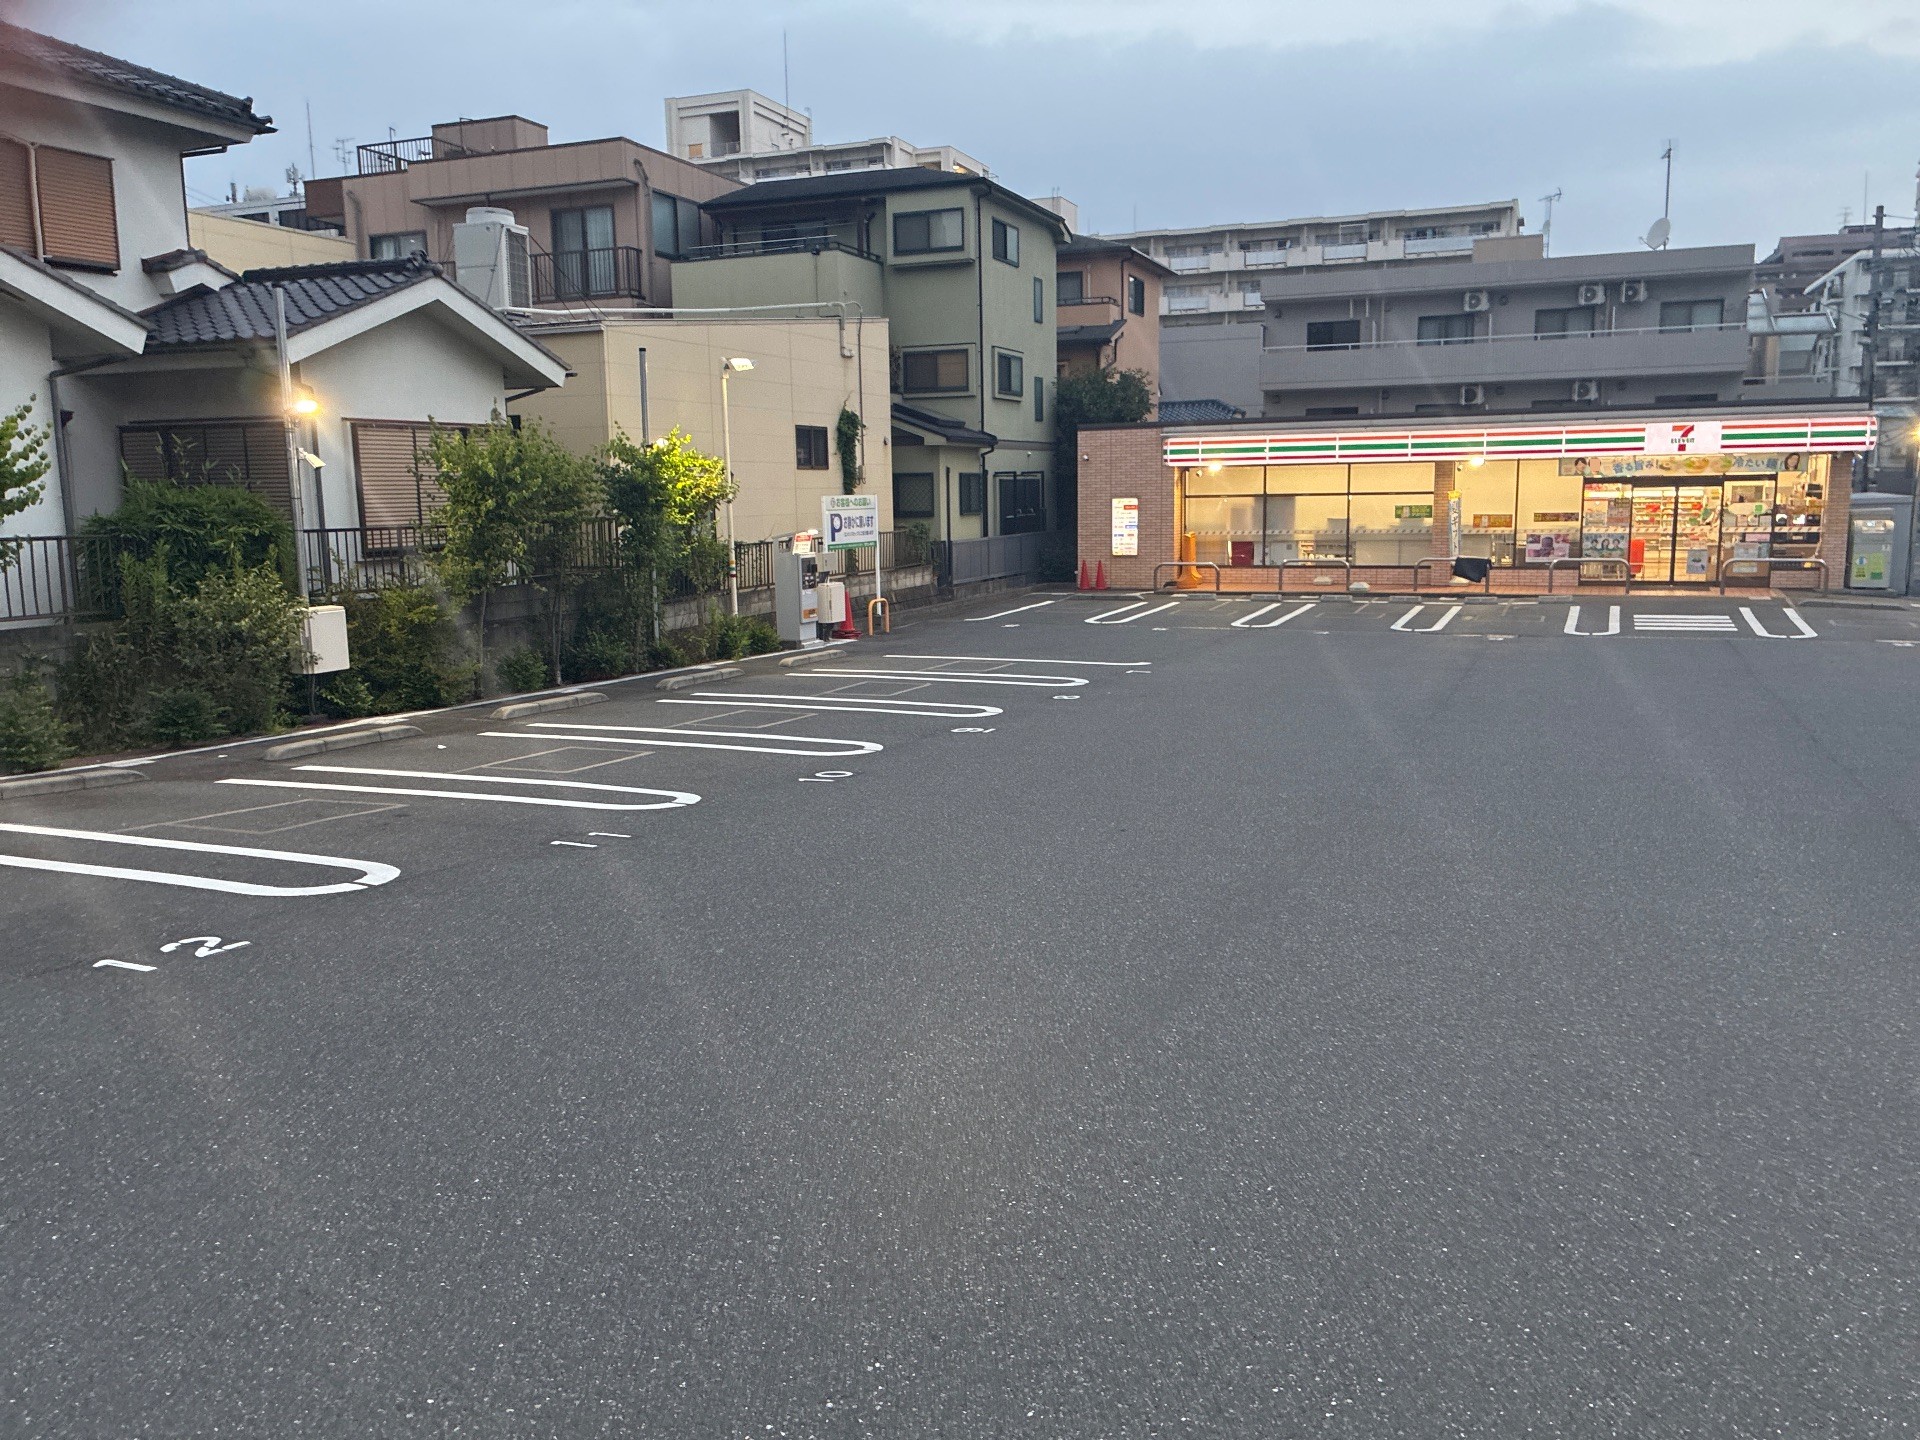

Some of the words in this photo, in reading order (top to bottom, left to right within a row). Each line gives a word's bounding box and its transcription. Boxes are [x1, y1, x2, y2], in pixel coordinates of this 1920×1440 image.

[1672, 424, 1695, 451] 7
[830, 513, 843, 542] P
[798, 770, 854, 783] 10
[550, 832, 632, 848] 11
[93, 936, 252, 973] 12
